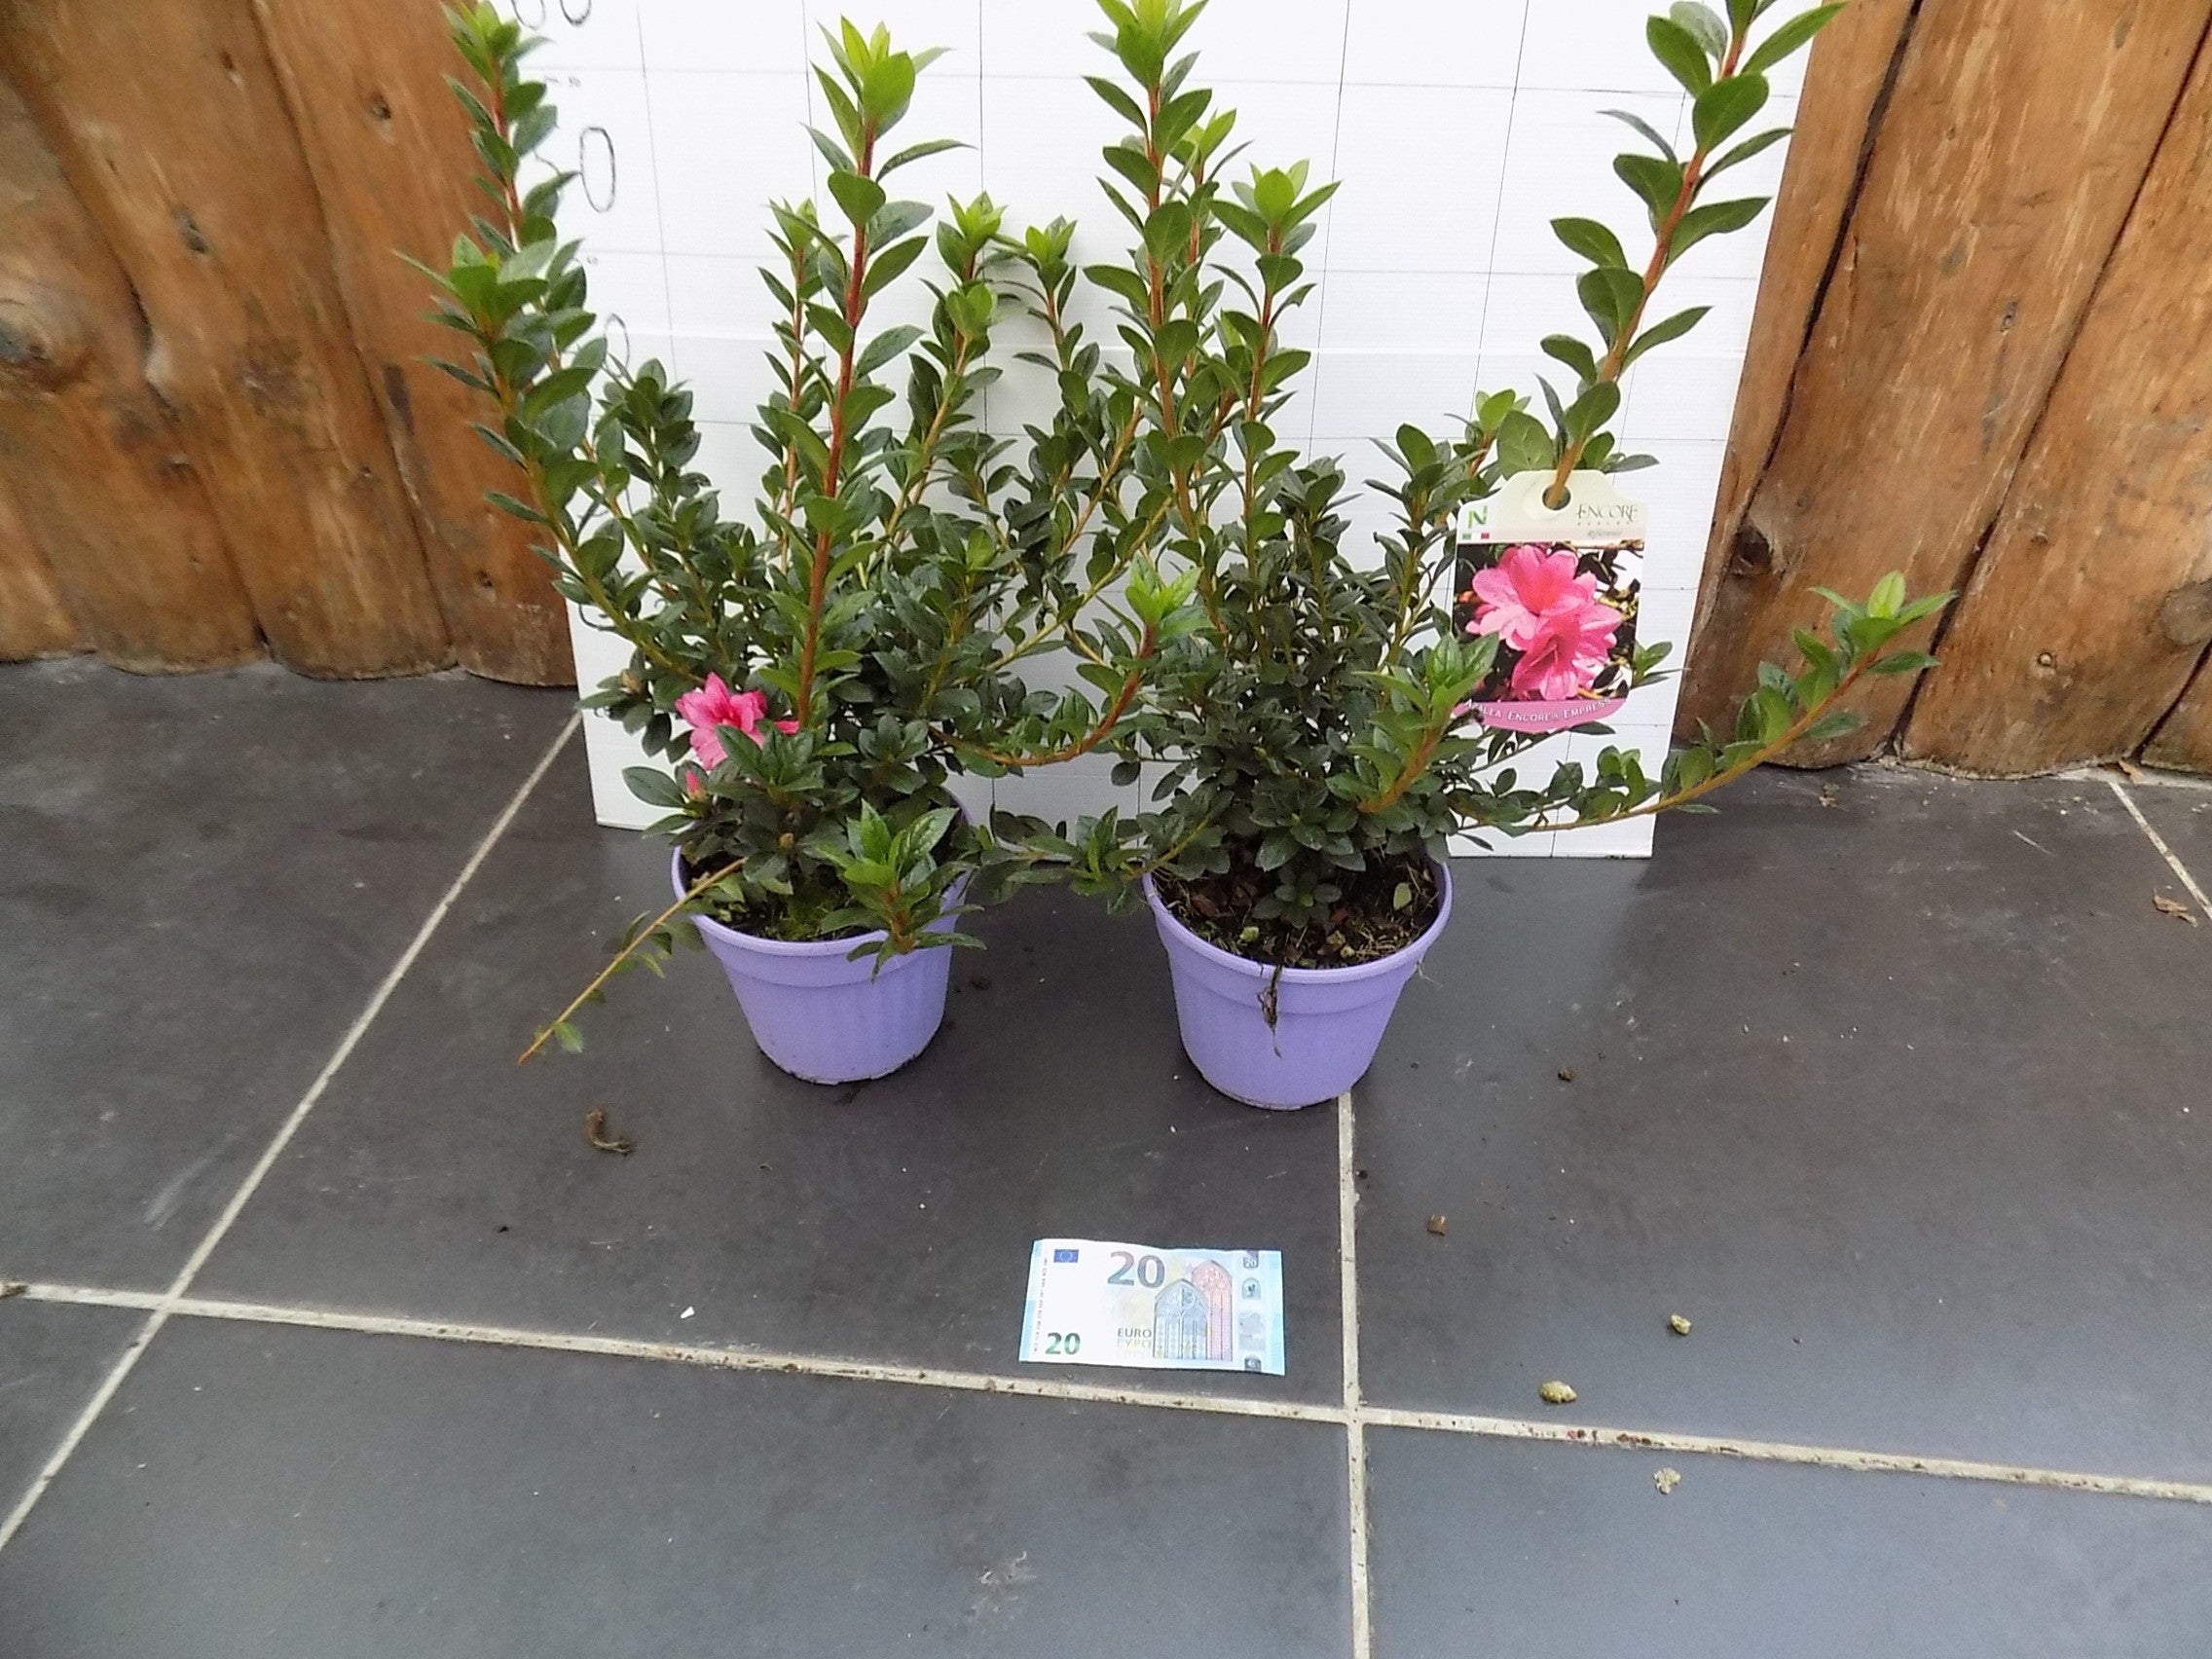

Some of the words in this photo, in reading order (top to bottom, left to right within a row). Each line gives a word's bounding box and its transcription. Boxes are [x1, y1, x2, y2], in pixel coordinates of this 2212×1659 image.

[1575, 503, 1638, 522] ENCORE
[1107, 1251, 1166, 1288] 20
[1045, 1332, 1081, 1355] 20
[1117, 1327, 1153, 1339] EURO
